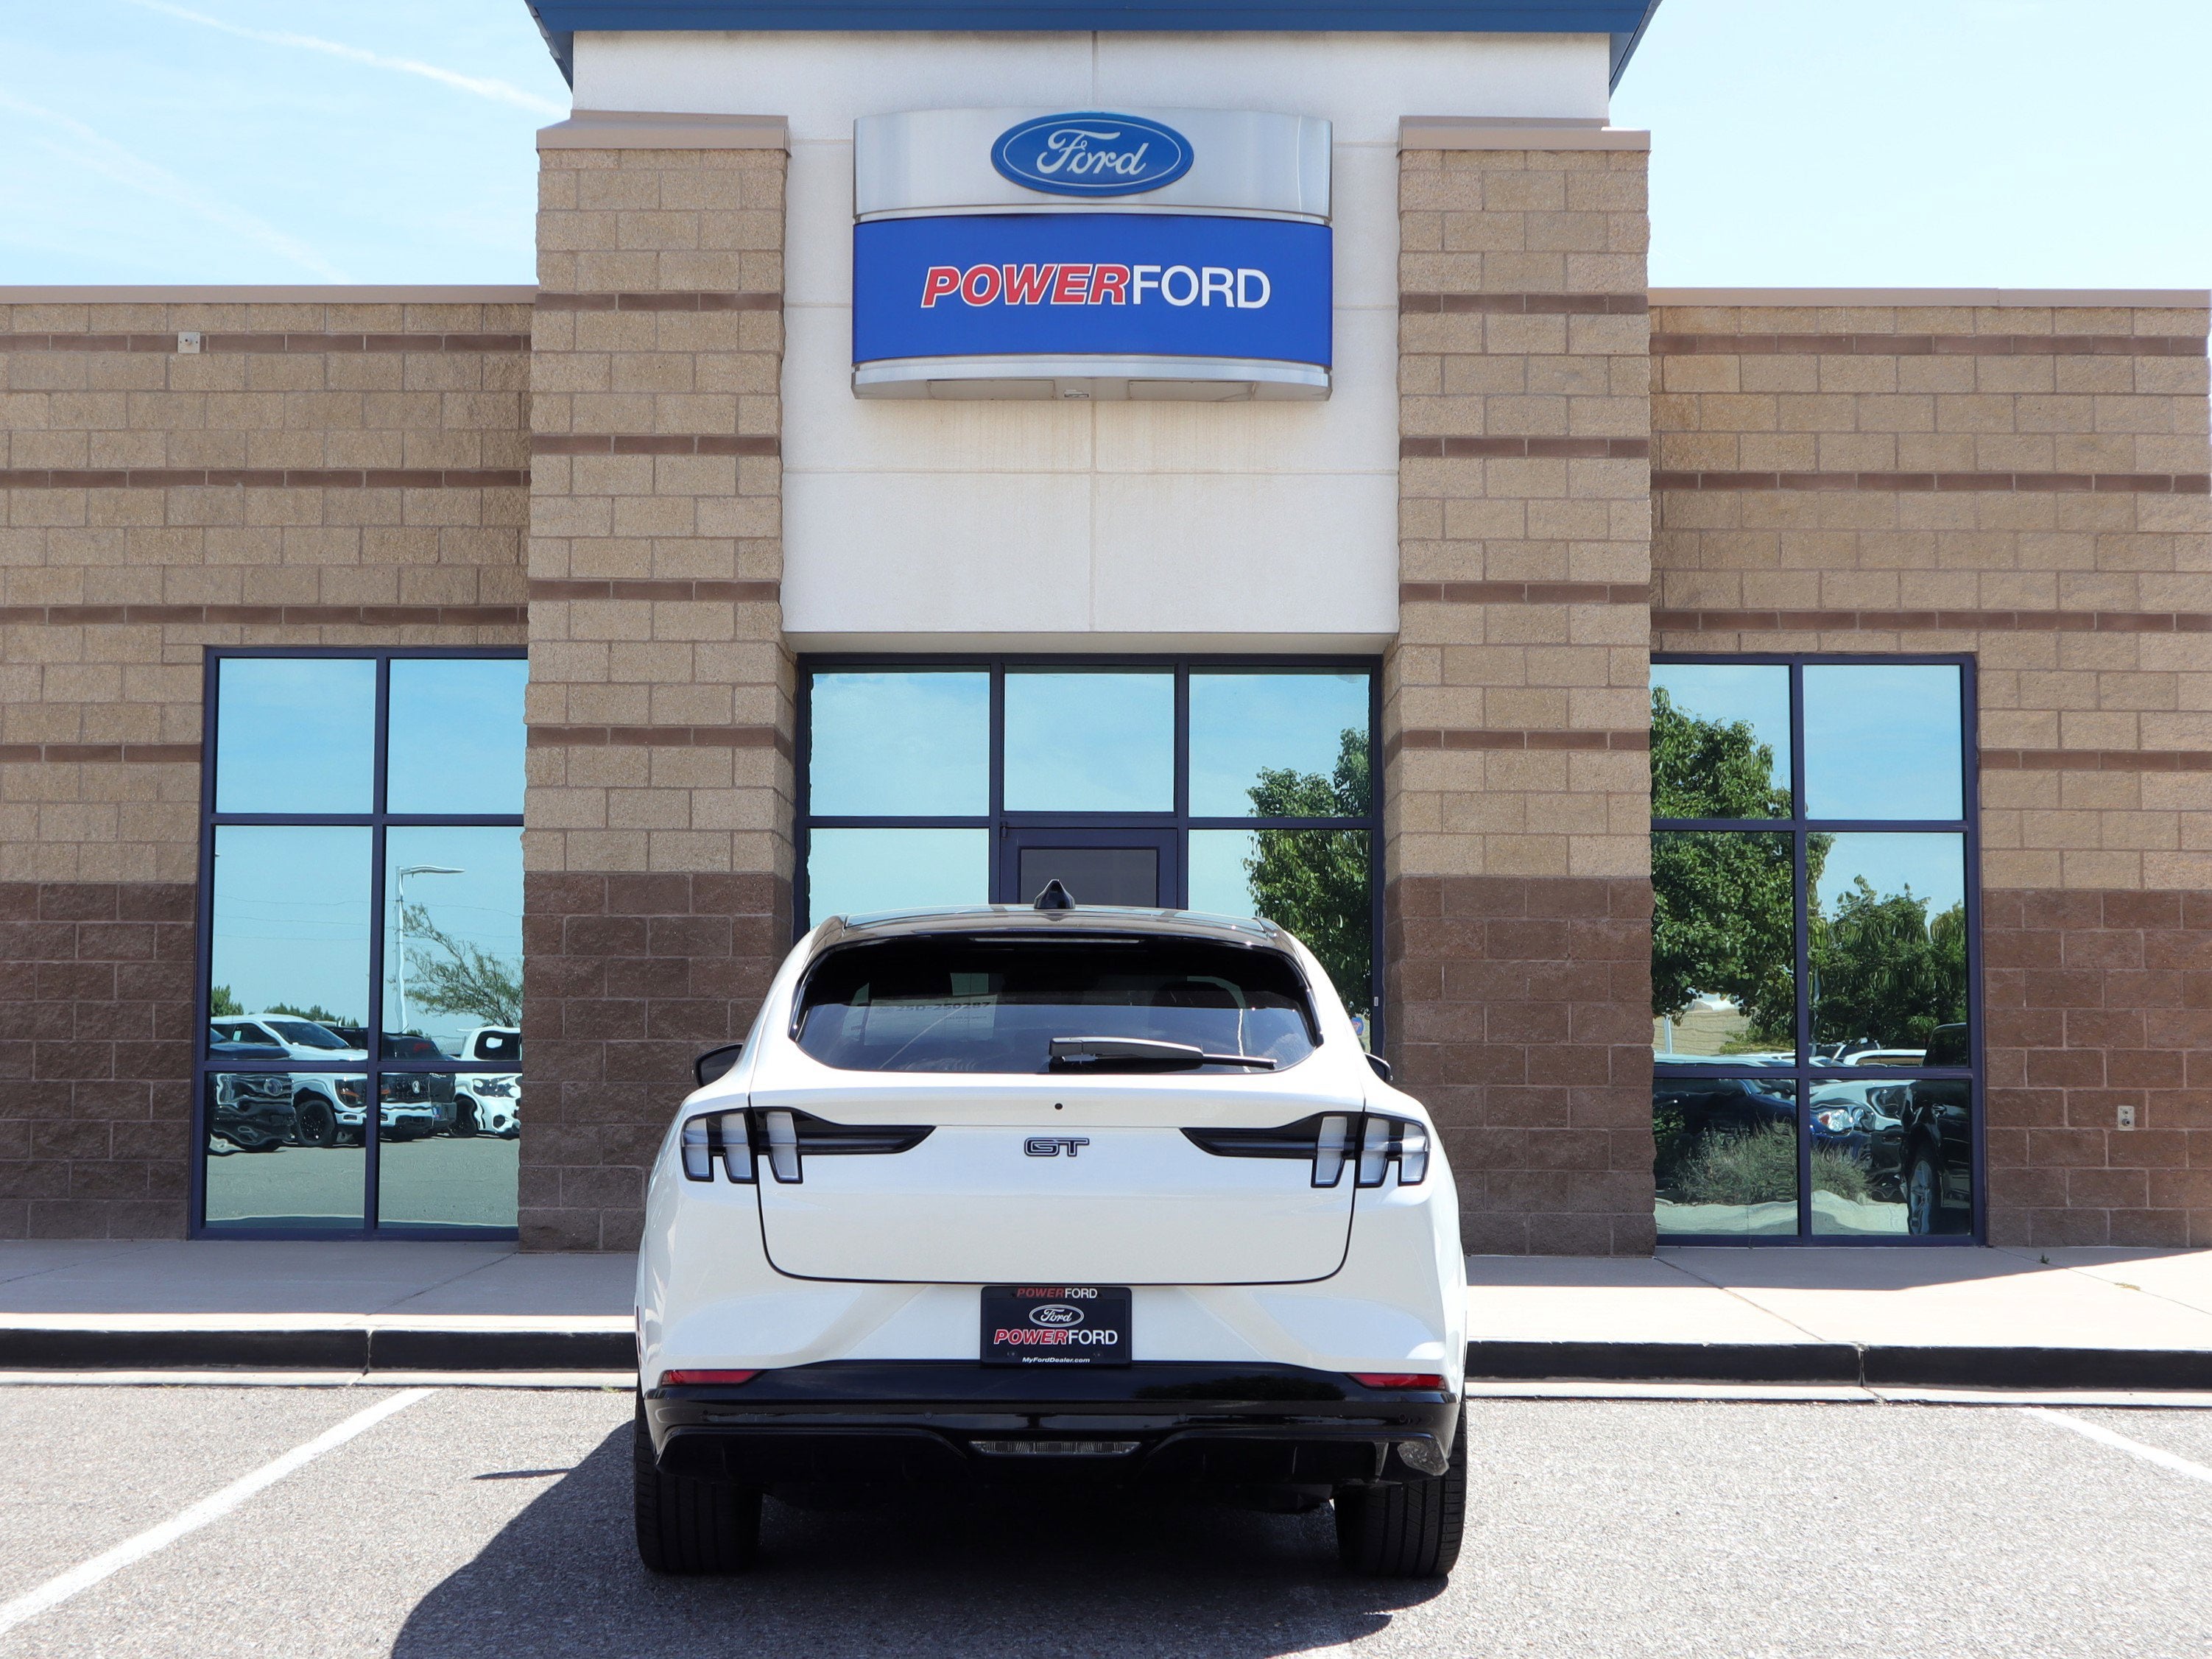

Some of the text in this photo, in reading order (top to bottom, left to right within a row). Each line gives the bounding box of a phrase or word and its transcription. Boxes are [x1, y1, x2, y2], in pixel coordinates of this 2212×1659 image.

[1035, 128, 1149, 177] Ford
[920, 263, 1271, 309] POWERFORD
[1024, 1137, 1090, 1157] GT
[1016, 1288, 1098, 1299] POWERFORD
[1040, 1308, 1073, 1322] Ford
[993, 1328, 1119, 1345] POWERFORD
